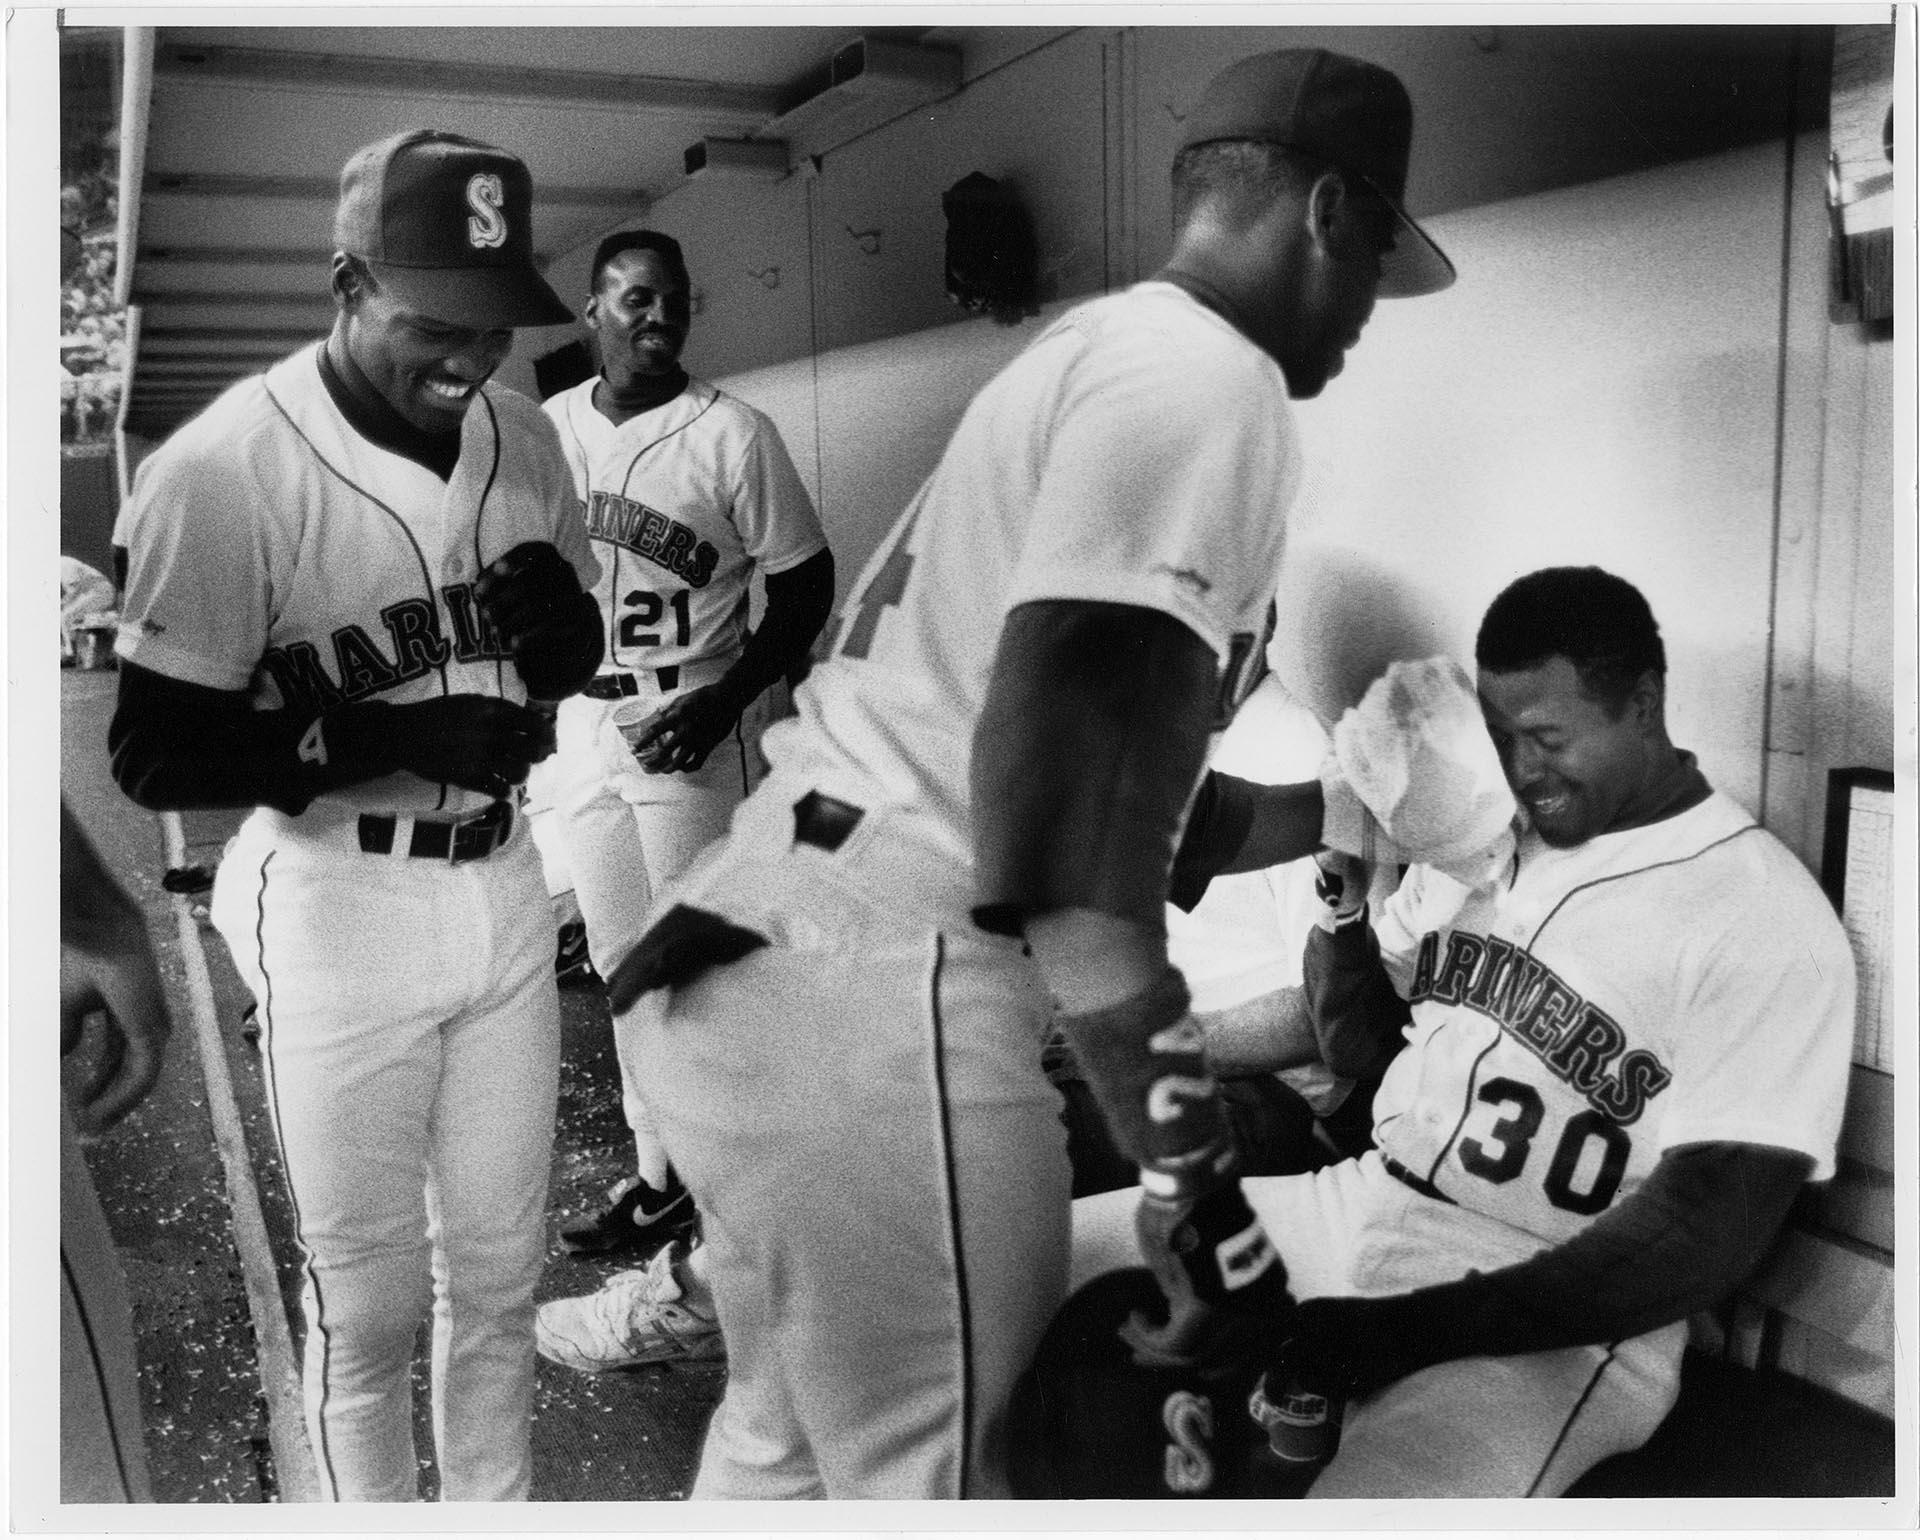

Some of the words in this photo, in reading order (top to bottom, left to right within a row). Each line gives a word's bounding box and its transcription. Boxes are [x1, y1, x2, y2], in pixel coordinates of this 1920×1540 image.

[466, 173, 507, 248] S
[577, 490, 720, 589] INERS
[620, 589, 691, 648] 21
[297, 715, 329, 766] 4
[1457, 1076, 1632, 1216] 30
[1162, 1390, 1213, 1492] S
